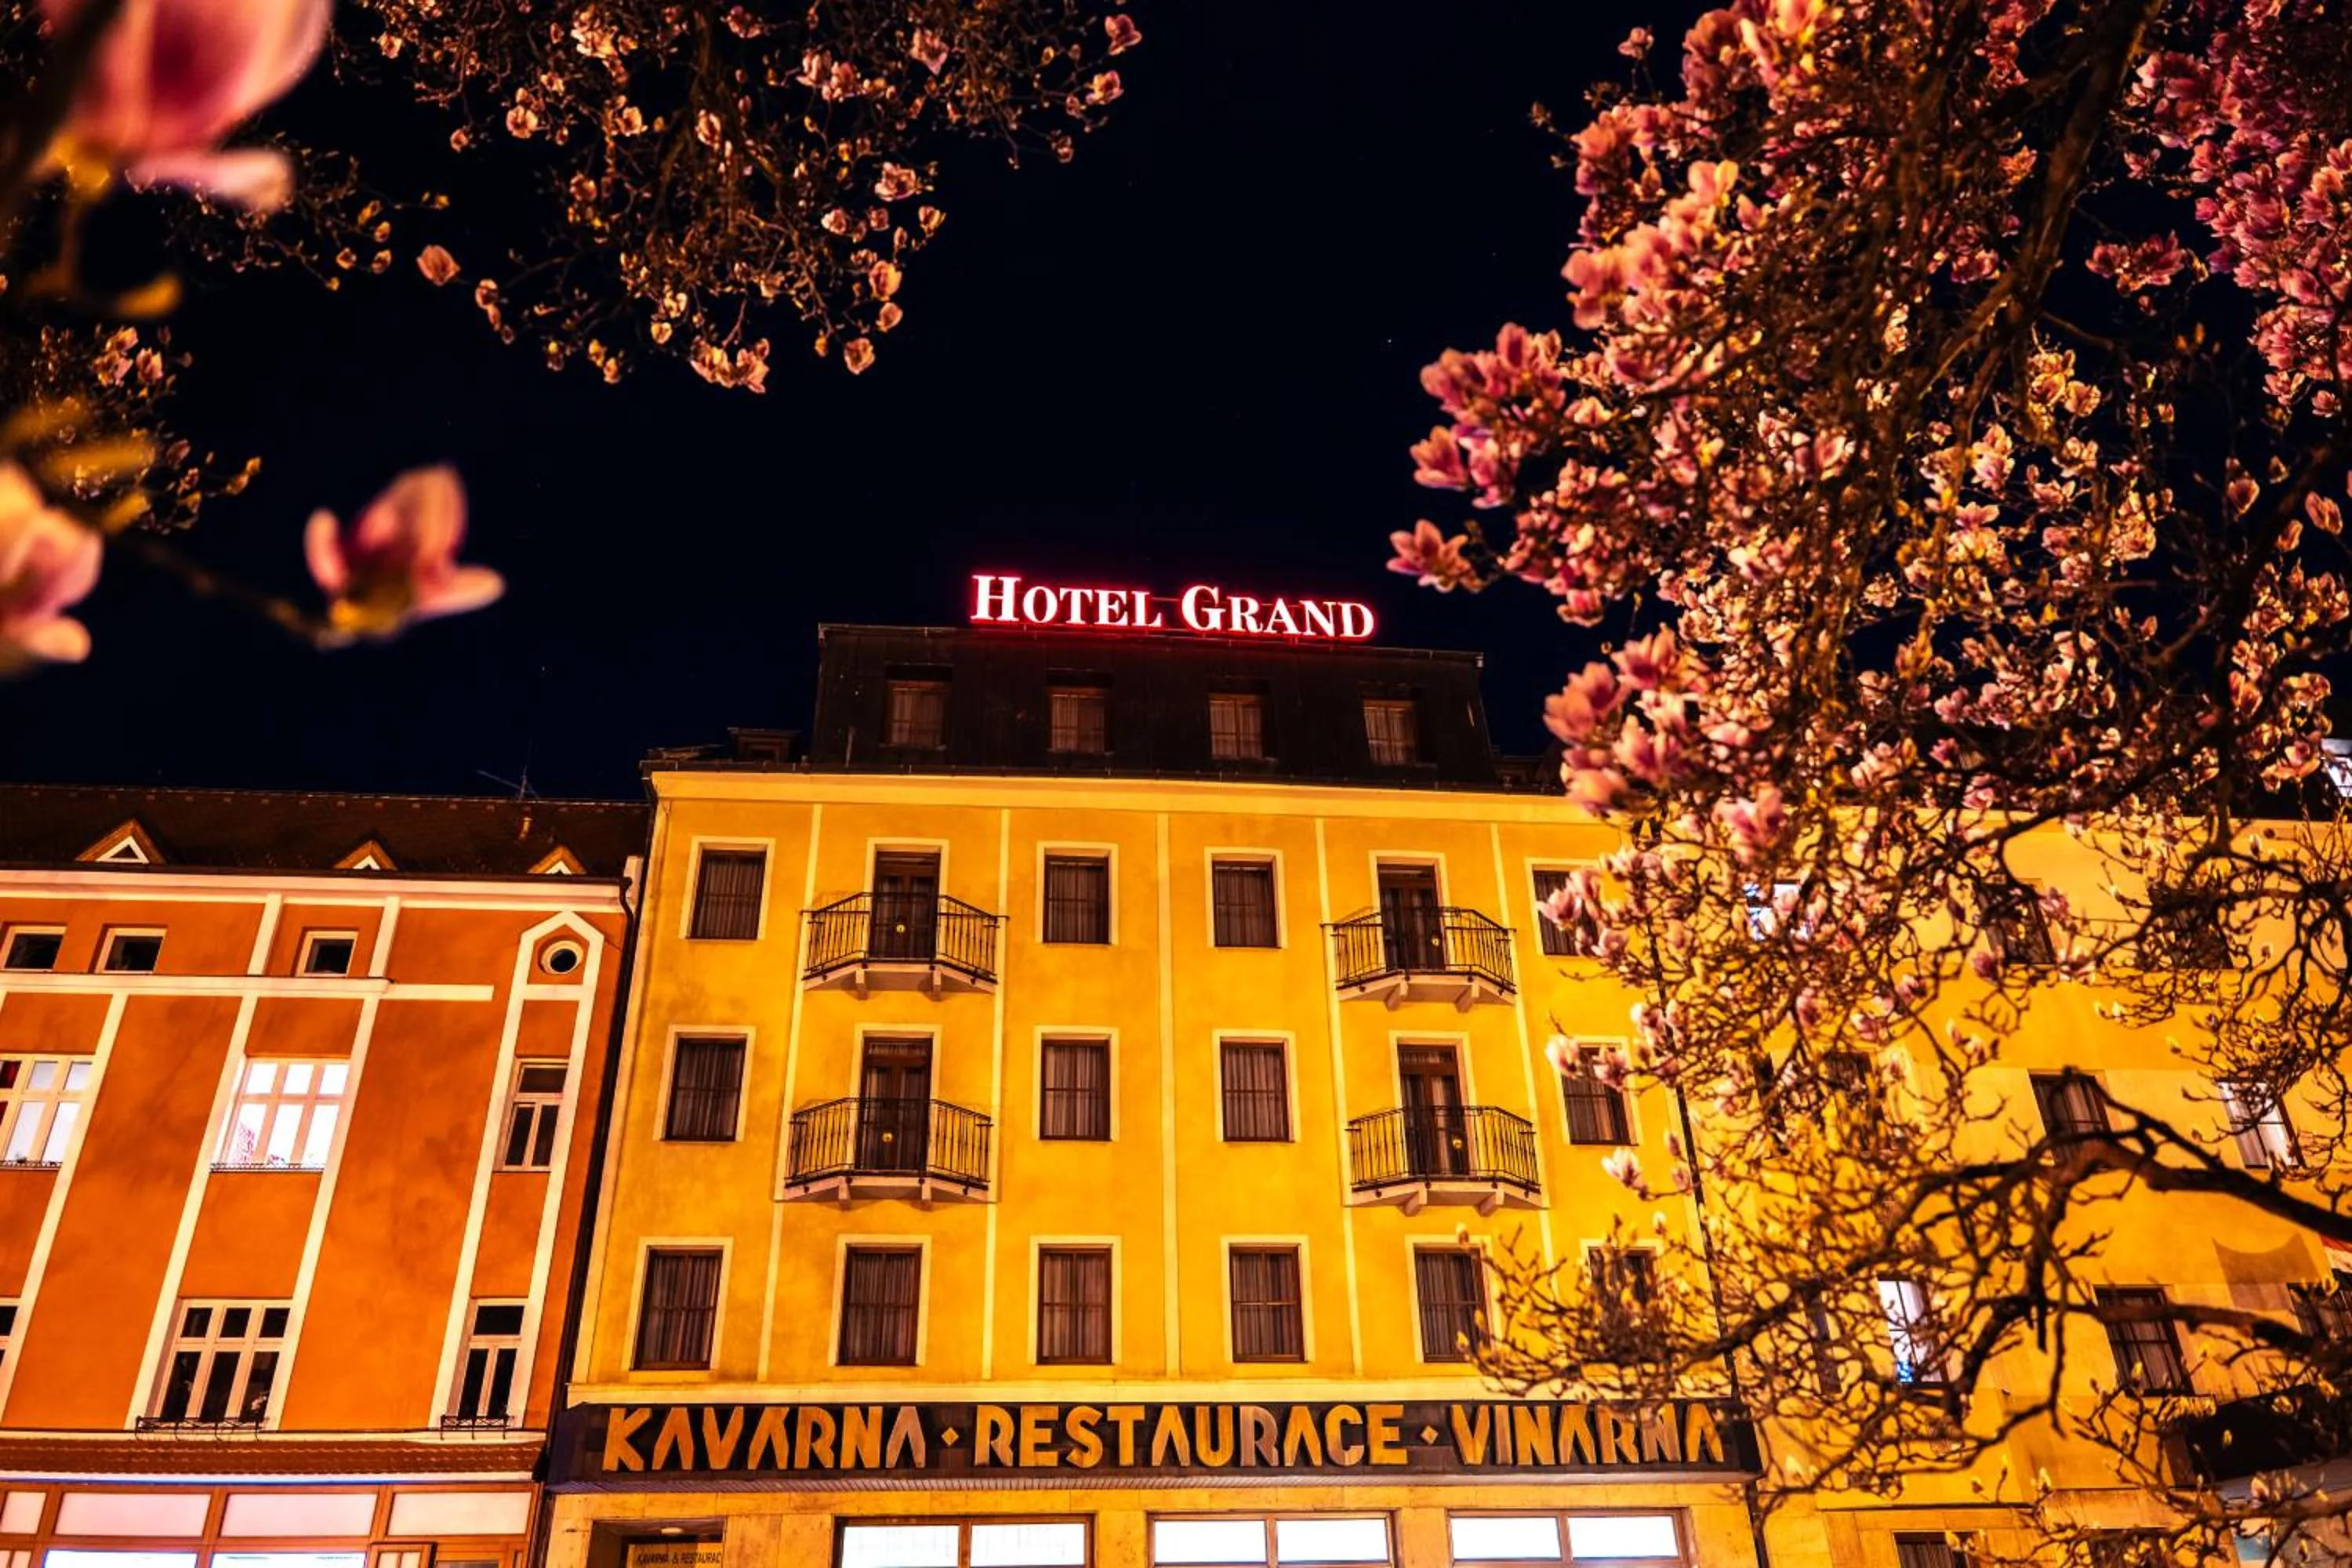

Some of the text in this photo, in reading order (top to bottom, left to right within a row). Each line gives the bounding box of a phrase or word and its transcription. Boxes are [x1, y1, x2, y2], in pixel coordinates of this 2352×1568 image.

[970, 574, 1374, 638] HOTEL GRAND
[974, 1404, 1408, 1468] RESTAURACE
